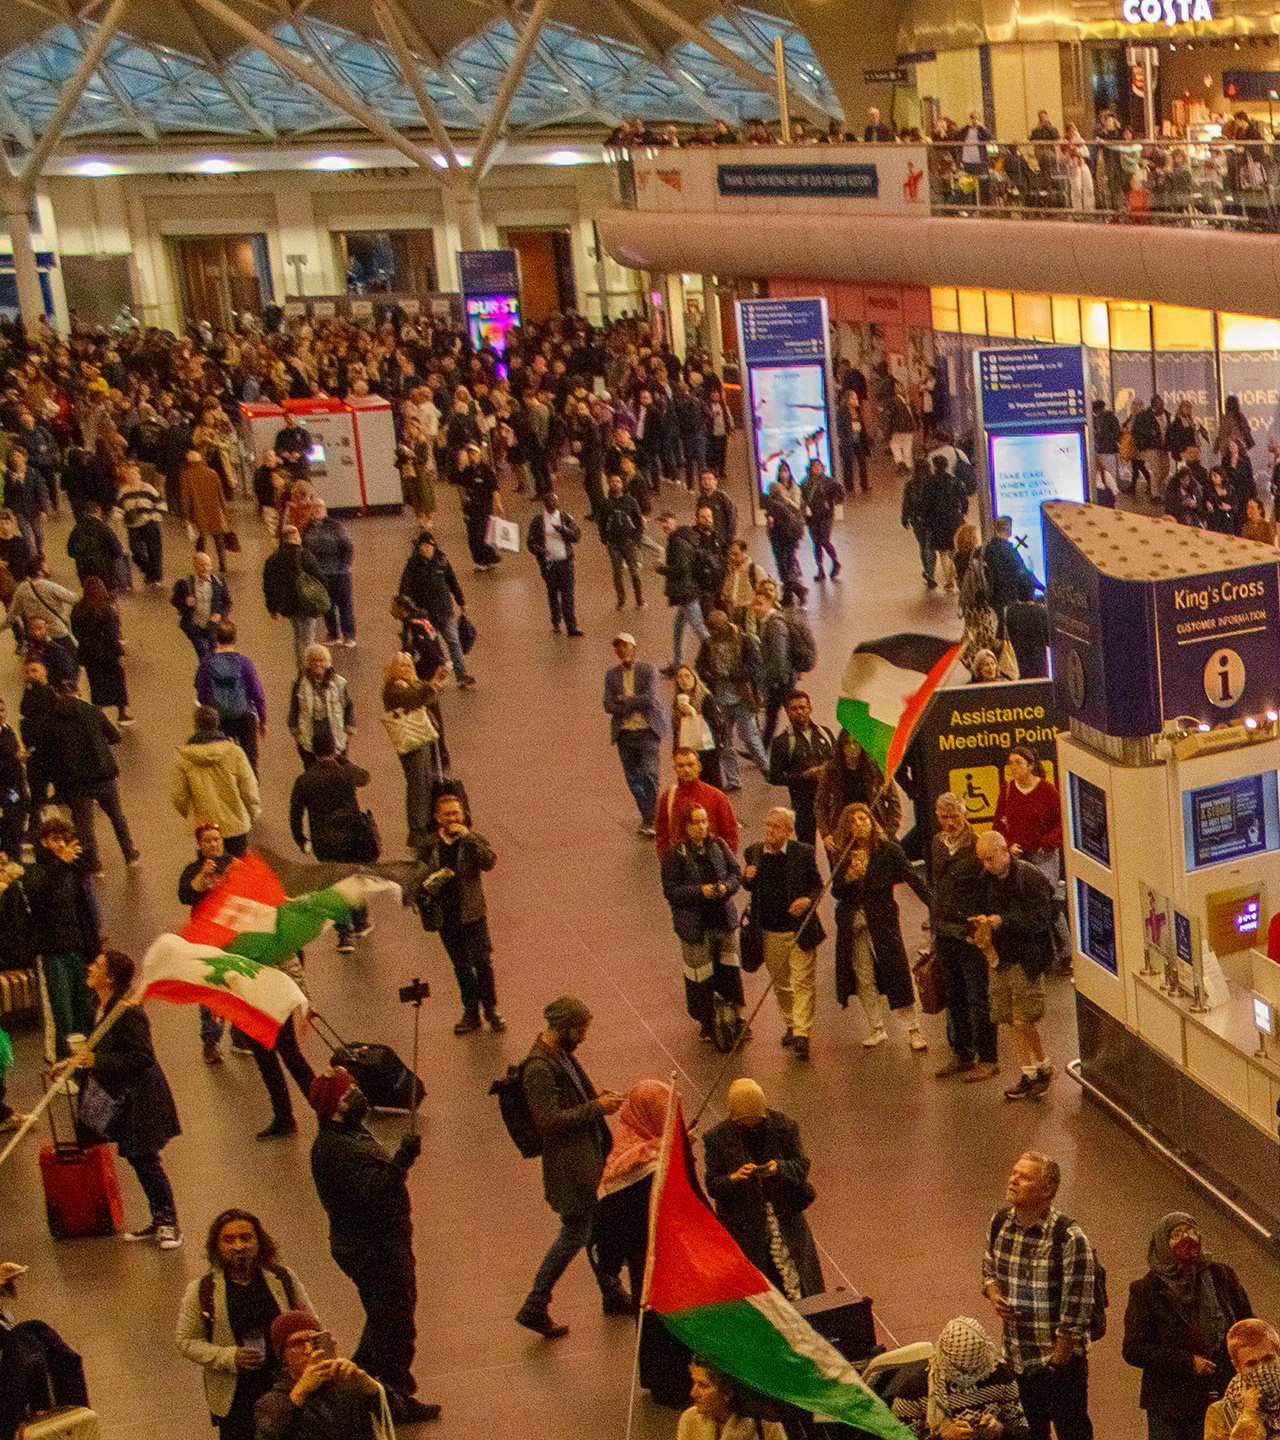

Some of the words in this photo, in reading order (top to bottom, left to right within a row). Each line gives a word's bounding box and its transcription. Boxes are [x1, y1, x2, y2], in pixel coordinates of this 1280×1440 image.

[1123, 0, 1213, 26] COSTA
[1174, 585, 1220, 610] King's
[1221, 580, 1264, 602] Cross
[1176, 618, 1216, 635] CUSTOMER
[1218, 609, 1267, 628] INFORMATION
[950, 705, 1045, 727] Assistance
[939, 730, 1011, 751] Meeting
[1015, 725, 1058, 743] Point
